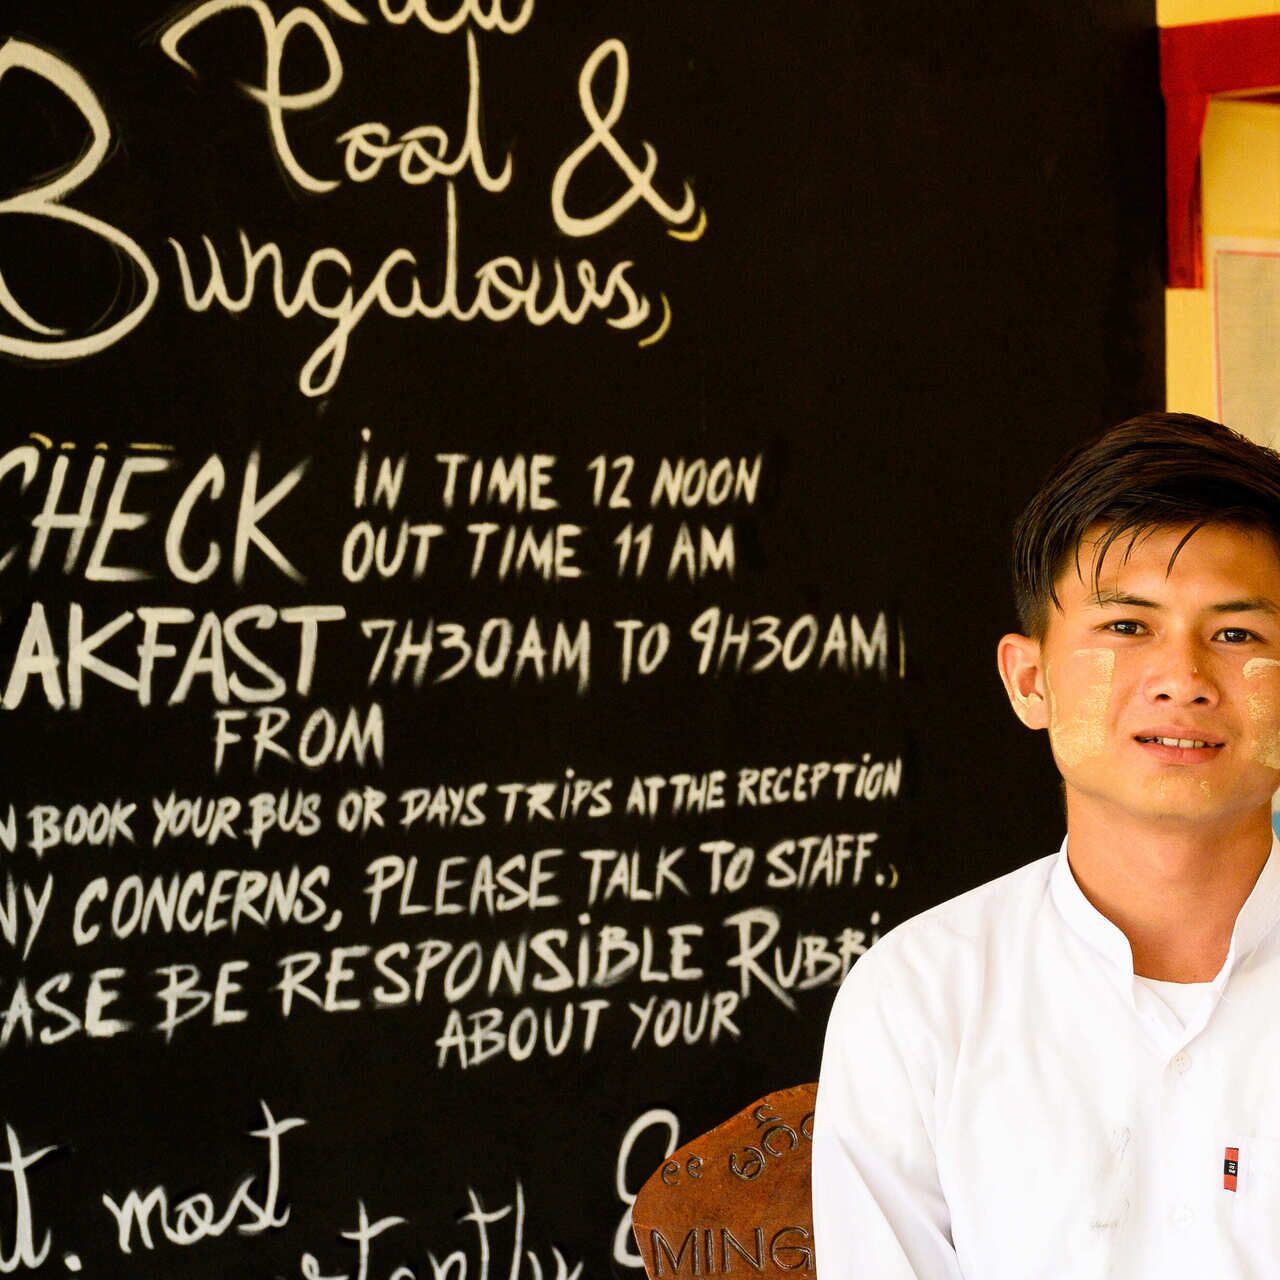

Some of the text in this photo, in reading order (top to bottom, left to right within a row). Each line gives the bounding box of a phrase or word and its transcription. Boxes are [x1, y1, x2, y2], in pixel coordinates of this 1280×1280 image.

[160, 0, 700, 240] Pool &
[436, 453, 558, 512] TIME
[588, 455, 634, 508] 12
[651, 456, 761, 507] NOON
[342, 521, 735, 582] OUT TIME 11 AM
[361, 617, 590, 690] 7H30AM
[614, 620, 670, 682] TO
[690, 607, 887, 674] 9H30AM
[214, 702, 384, 772] FROM
[27, 800, 137, 857] BOOK
[153, 792, 241, 847] YOUR
[246, 789, 321, 849] BUS
[337, 786, 387, 832] OR
[399, 782, 488, 828] DAYS
[73, 865, 342, 948] CONCERNS,
[364, 849, 564, 923] PLEASE
[580, 848, 687, 905] TALK
[699, 840, 755, 894] TO
[156, 960, 249, 1042] BE
[435, 990, 742, 1069] ABOUT YOUR
[102, 1101, 312, 1258] most
